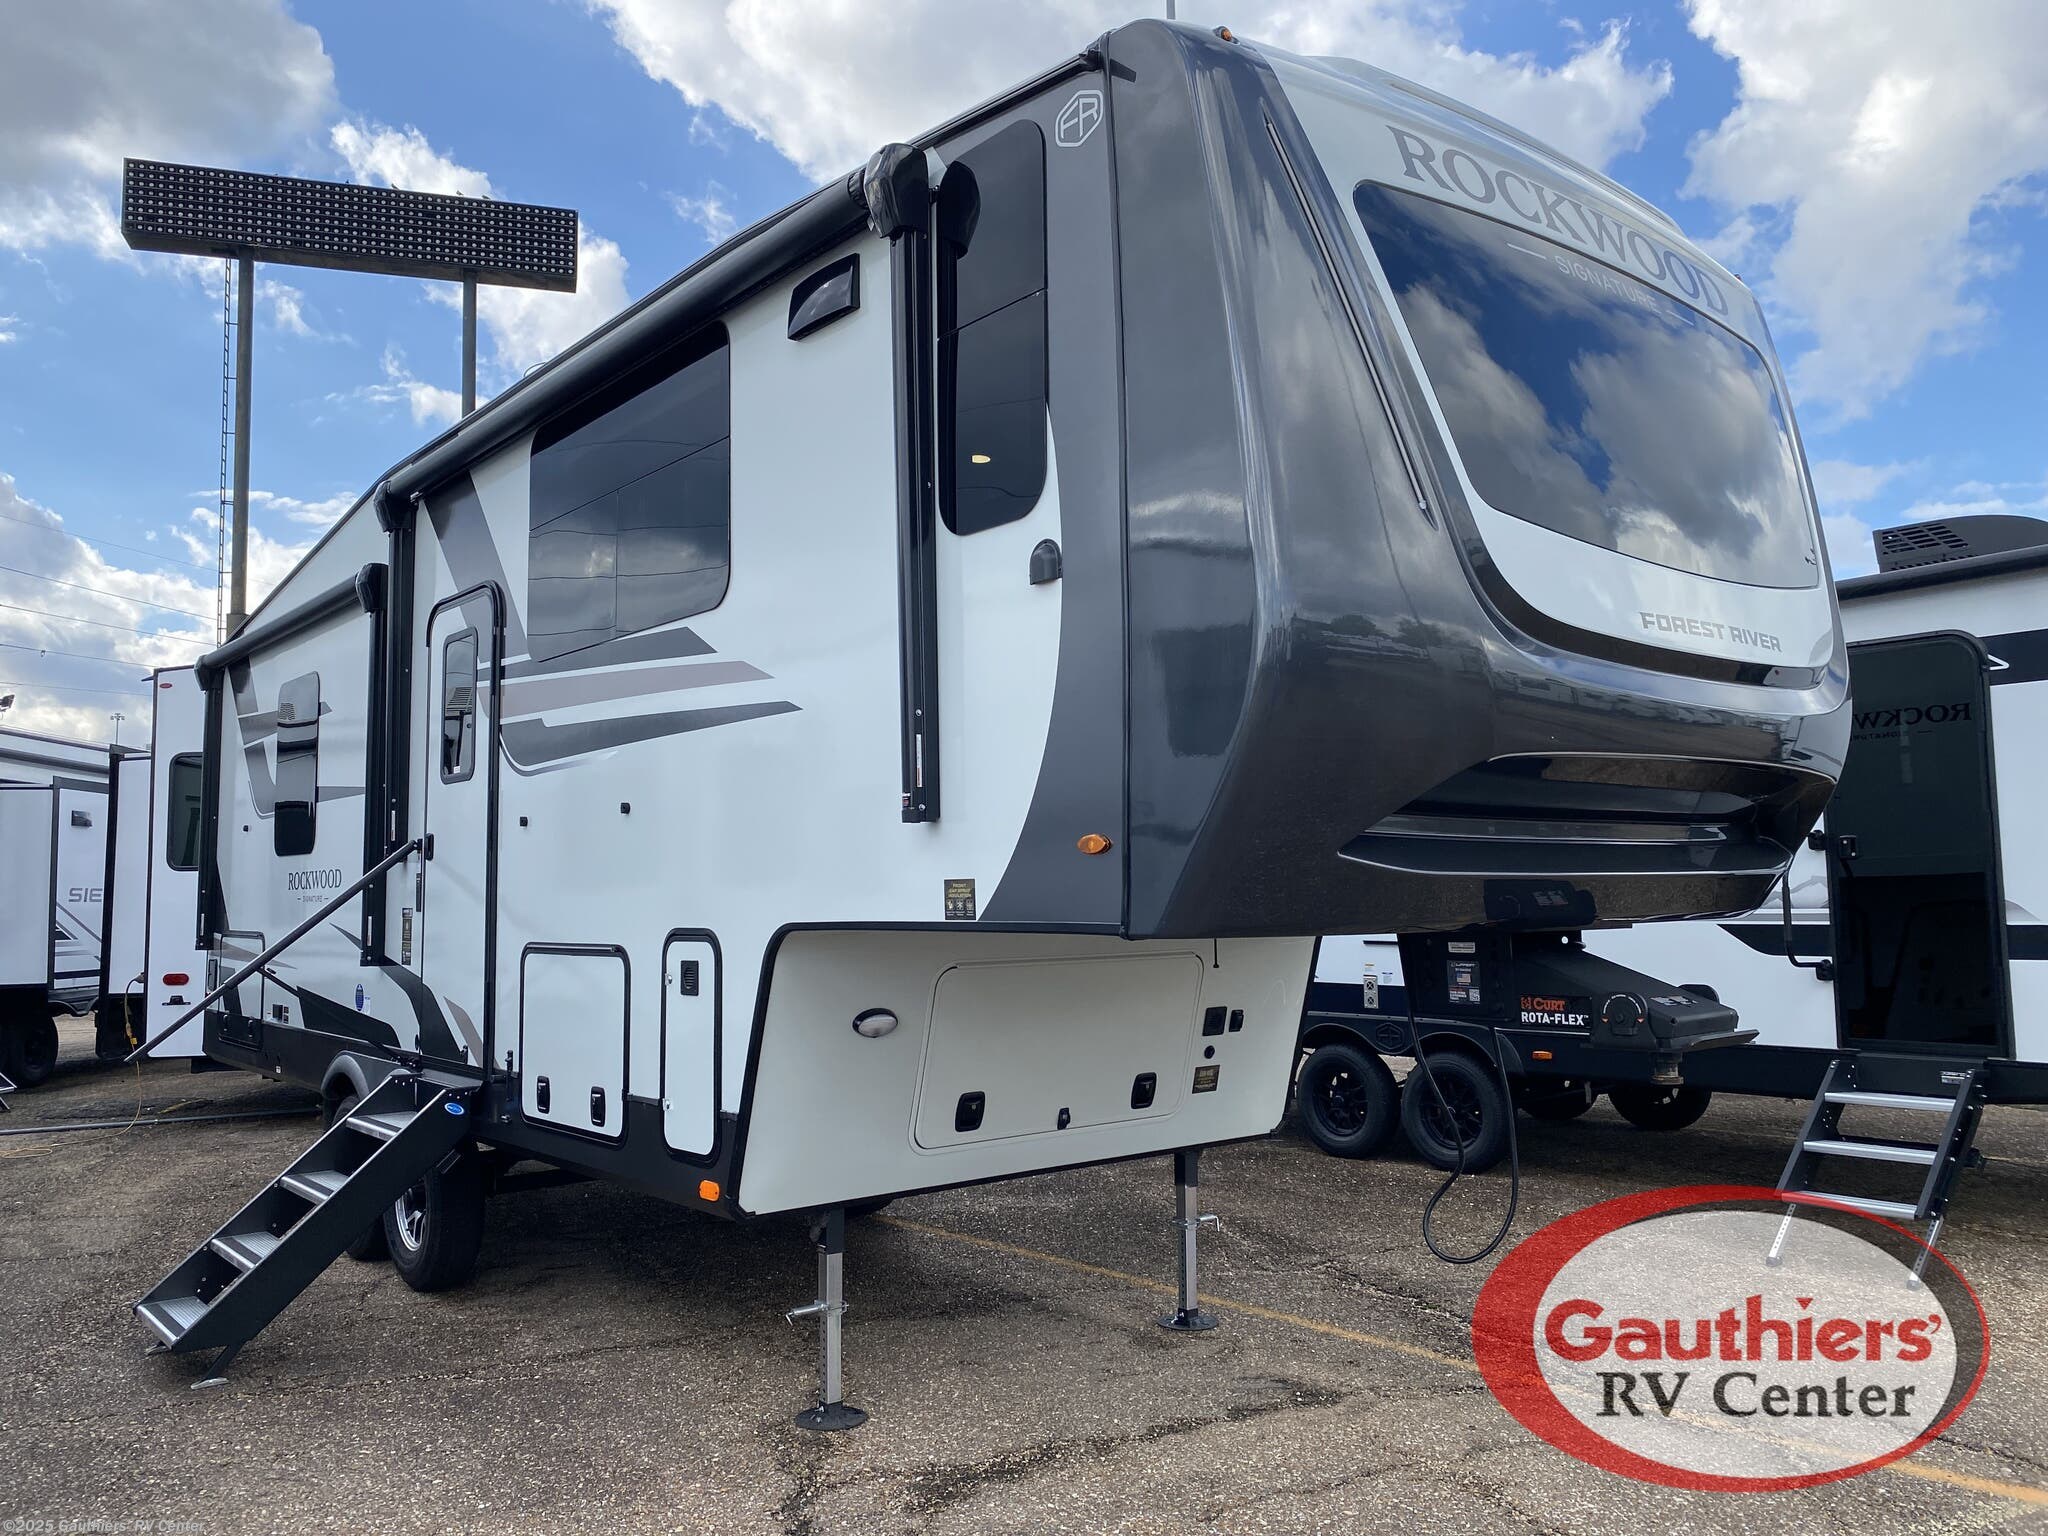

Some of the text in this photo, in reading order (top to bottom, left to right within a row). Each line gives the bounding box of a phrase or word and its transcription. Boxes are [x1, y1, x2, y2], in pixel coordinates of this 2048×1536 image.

[1385, 125, 1729, 316] ROCKWOOD
[1554, 255, 1662, 315] SIGNATURE
[1639, 611, 1783, 652] FOREST RIVER
[68, 887, 103, 903] SIE
[288, 868, 342, 891] ROCKWOOD
